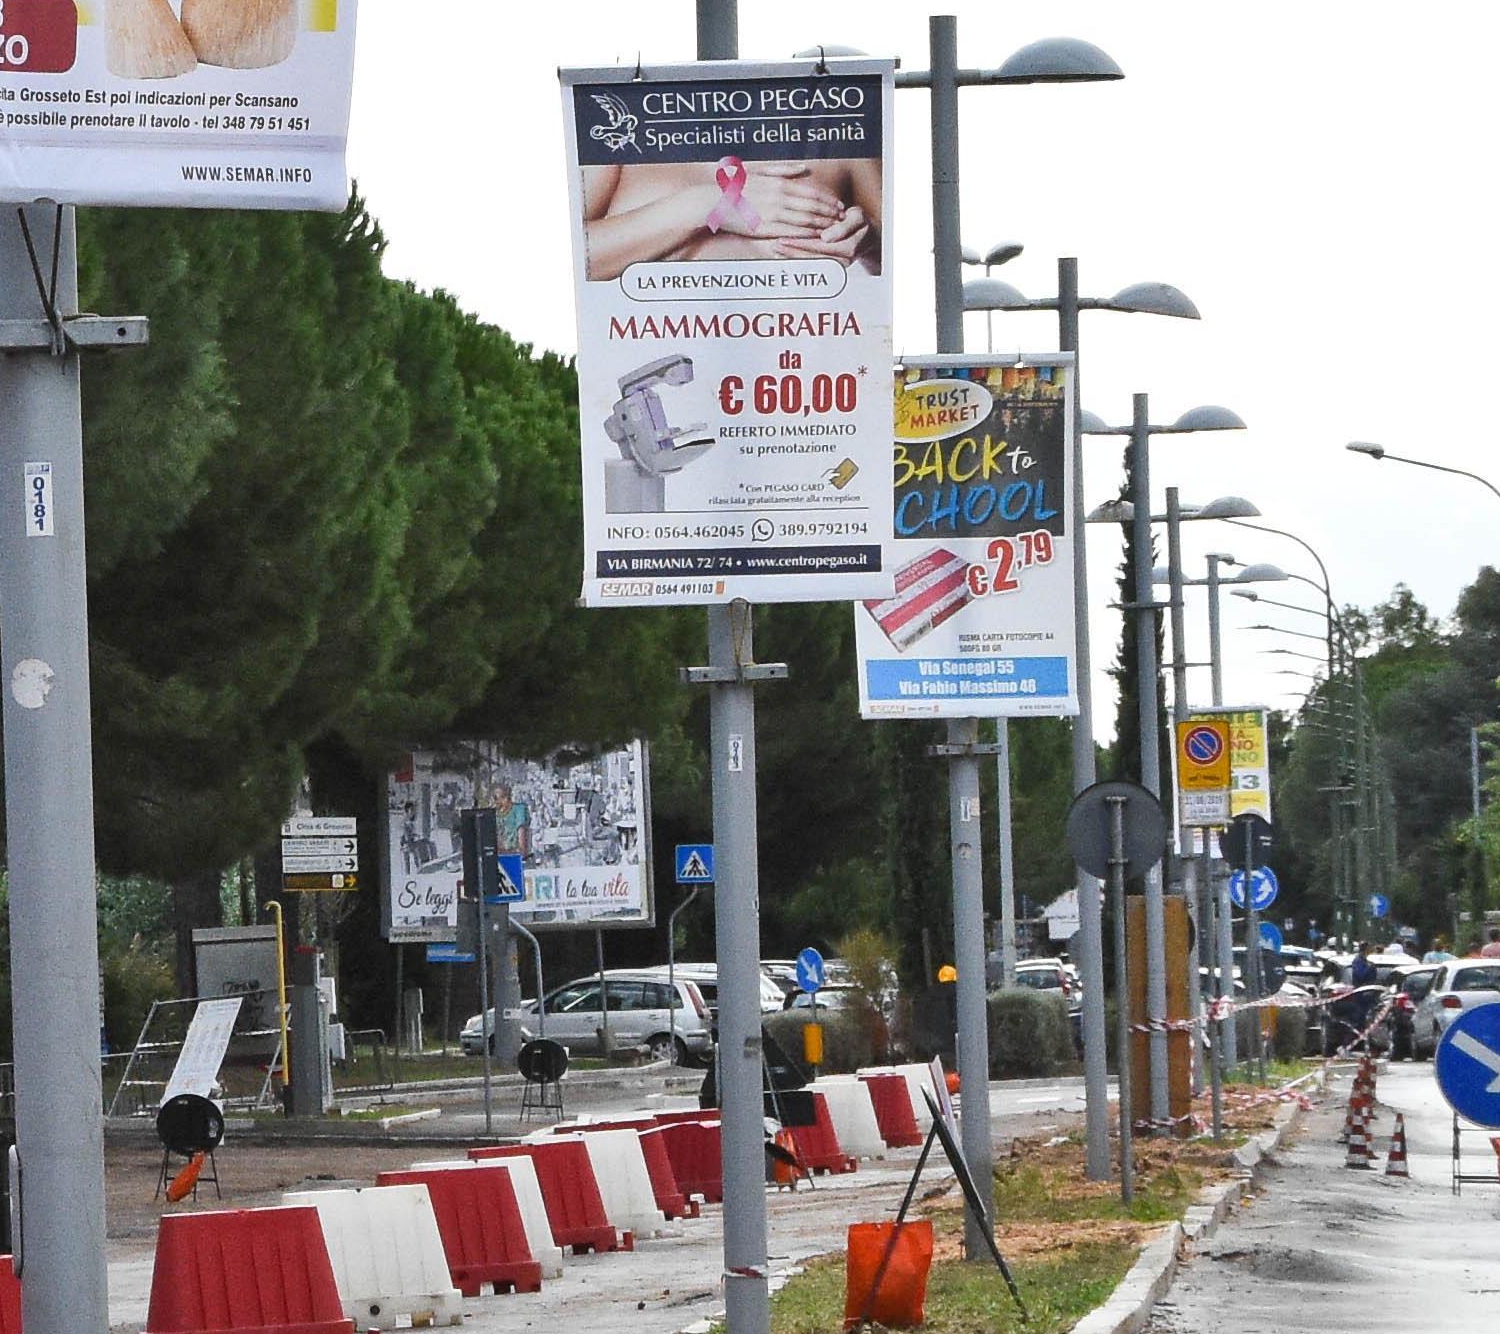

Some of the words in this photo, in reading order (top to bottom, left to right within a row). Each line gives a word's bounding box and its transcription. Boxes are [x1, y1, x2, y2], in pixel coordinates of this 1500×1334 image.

[20, 88, 81, 104] Grosseto
[85, 90, 106, 104] Est
[110, 91, 131, 107] poi
[135, 91, 206, 106] indicazioni
[209, 94, 231, 110] per
[234, 93, 299, 108] Scansano
[642, 90, 751, 115] CENTRO
[760, 87, 864, 111] PEGASO
[7, 110, 67, 126] possibile
[71, 114, 135, 129] prenotare
[139, 114, 146, 128] il
[150, 115, 190, 128] tavolo
[202, 116, 218, 129] tel
[222, 117, 245, 129] 348
[250, 117, 265, 130] 79
[268, 117, 283, 130] 51
[287, 117, 310, 130] 451
[645, 125, 745, 151] Specialisti
[753, 124, 800, 143] della
[807, 122, 865, 142] sanità
[182, 166, 311, 182] WWW.SEMAR.INFO
[637, 276, 656, 289] LA
[662, 274, 775, 289] PREVENZIONE
[781, 270, 788, 286] È
[795, 273, 828, 286] VITA
[609, 311, 861, 340] MAMMOGRAFIA
[779, 350, 801, 370] da
[916, 388, 970, 410] TRUST
[910, 405, 979, 429] MARKET
[719, 426, 776, 438] REFERTO
[780, 424, 856, 437] IMMEDIATO
[739, 445, 753, 454] su
[757, 443, 837, 457] prenotazione
[1006, 445, 1037, 475] to
[764, 484, 799, 492] PEGASO
[33, 476, 46, 531] 0181
[895, 479, 1058, 535] CHOOL
[607, 527, 650, 539] INFO:
[654, 525, 745, 539] 0564.462045
[779, 522, 868, 536] 389.9792194
[607, 557, 628, 570] VIA
[631, 557, 693, 569] BIRMANIA
[747, 555, 868, 569] www.centropegaso.it
[602, 583, 651, 596] SEMAR
[655, 584, 677, 595] 0564
[680, 584, 713, 595] 491103
[982, 634, 1003, 642] CARTA
[919, 661, 942, 675] Via
[944, 660, 994, 677] Senegal
[997, 660, 1014, 675] 55
[900, 681, 920, 694] Via
[923, 680, 957, 694] Fabio
[960, 679, 1017, 694] Massimo
[566, 879, 577, 898] la
[603, 872, 630, 897] vita
[399, 880, 422, 908] Se
[425, 887, 453, 915] leggi
